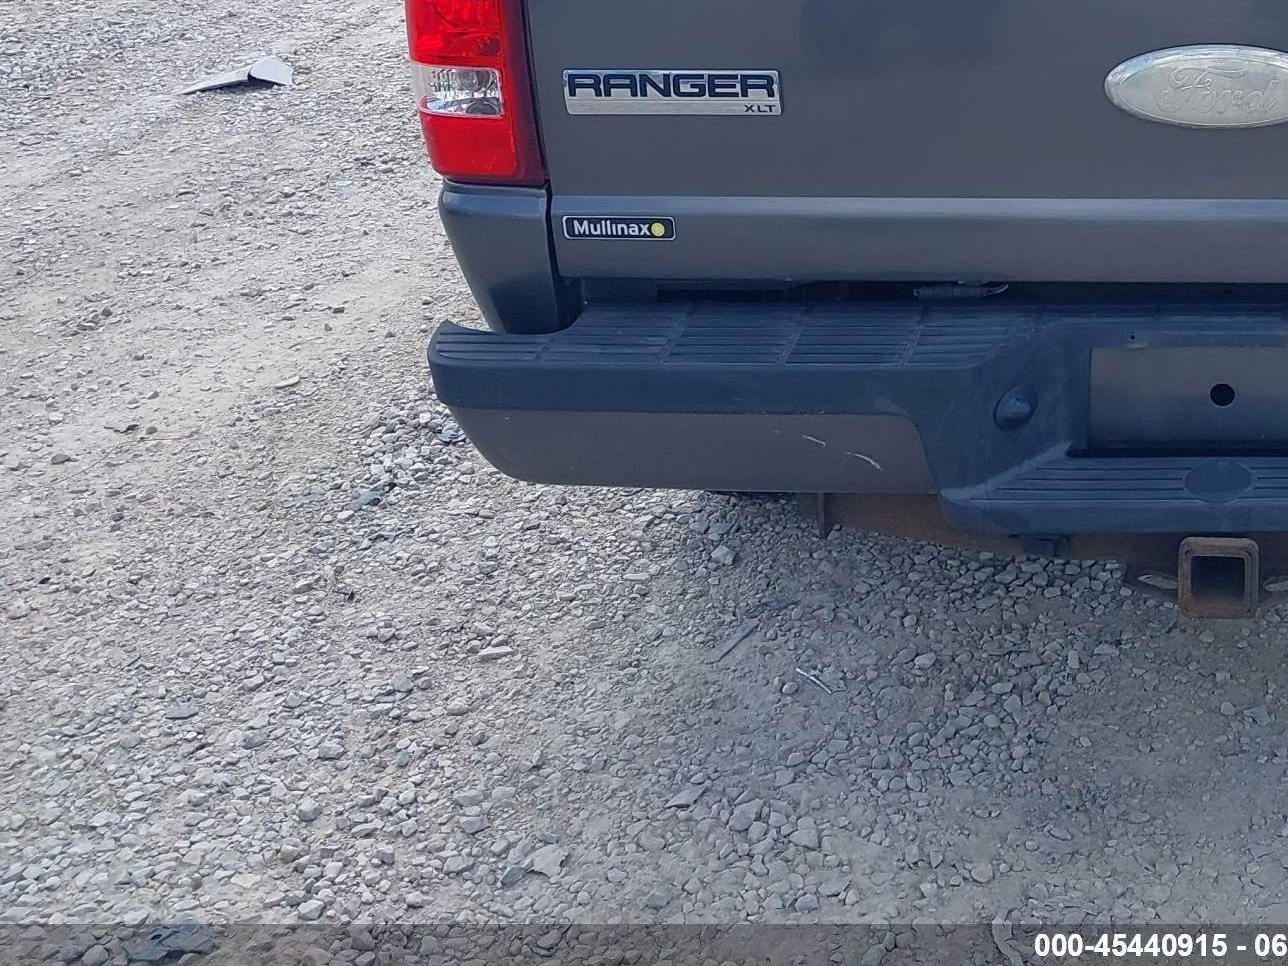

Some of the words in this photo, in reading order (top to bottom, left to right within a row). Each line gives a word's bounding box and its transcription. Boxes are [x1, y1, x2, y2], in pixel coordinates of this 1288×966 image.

[567, 73, 775, 97] RANGER
[1156, 64, 1281, 115] Ford
[744, 104, 776, 113] XLT
[572, 219, 652, 236] Mullinax
